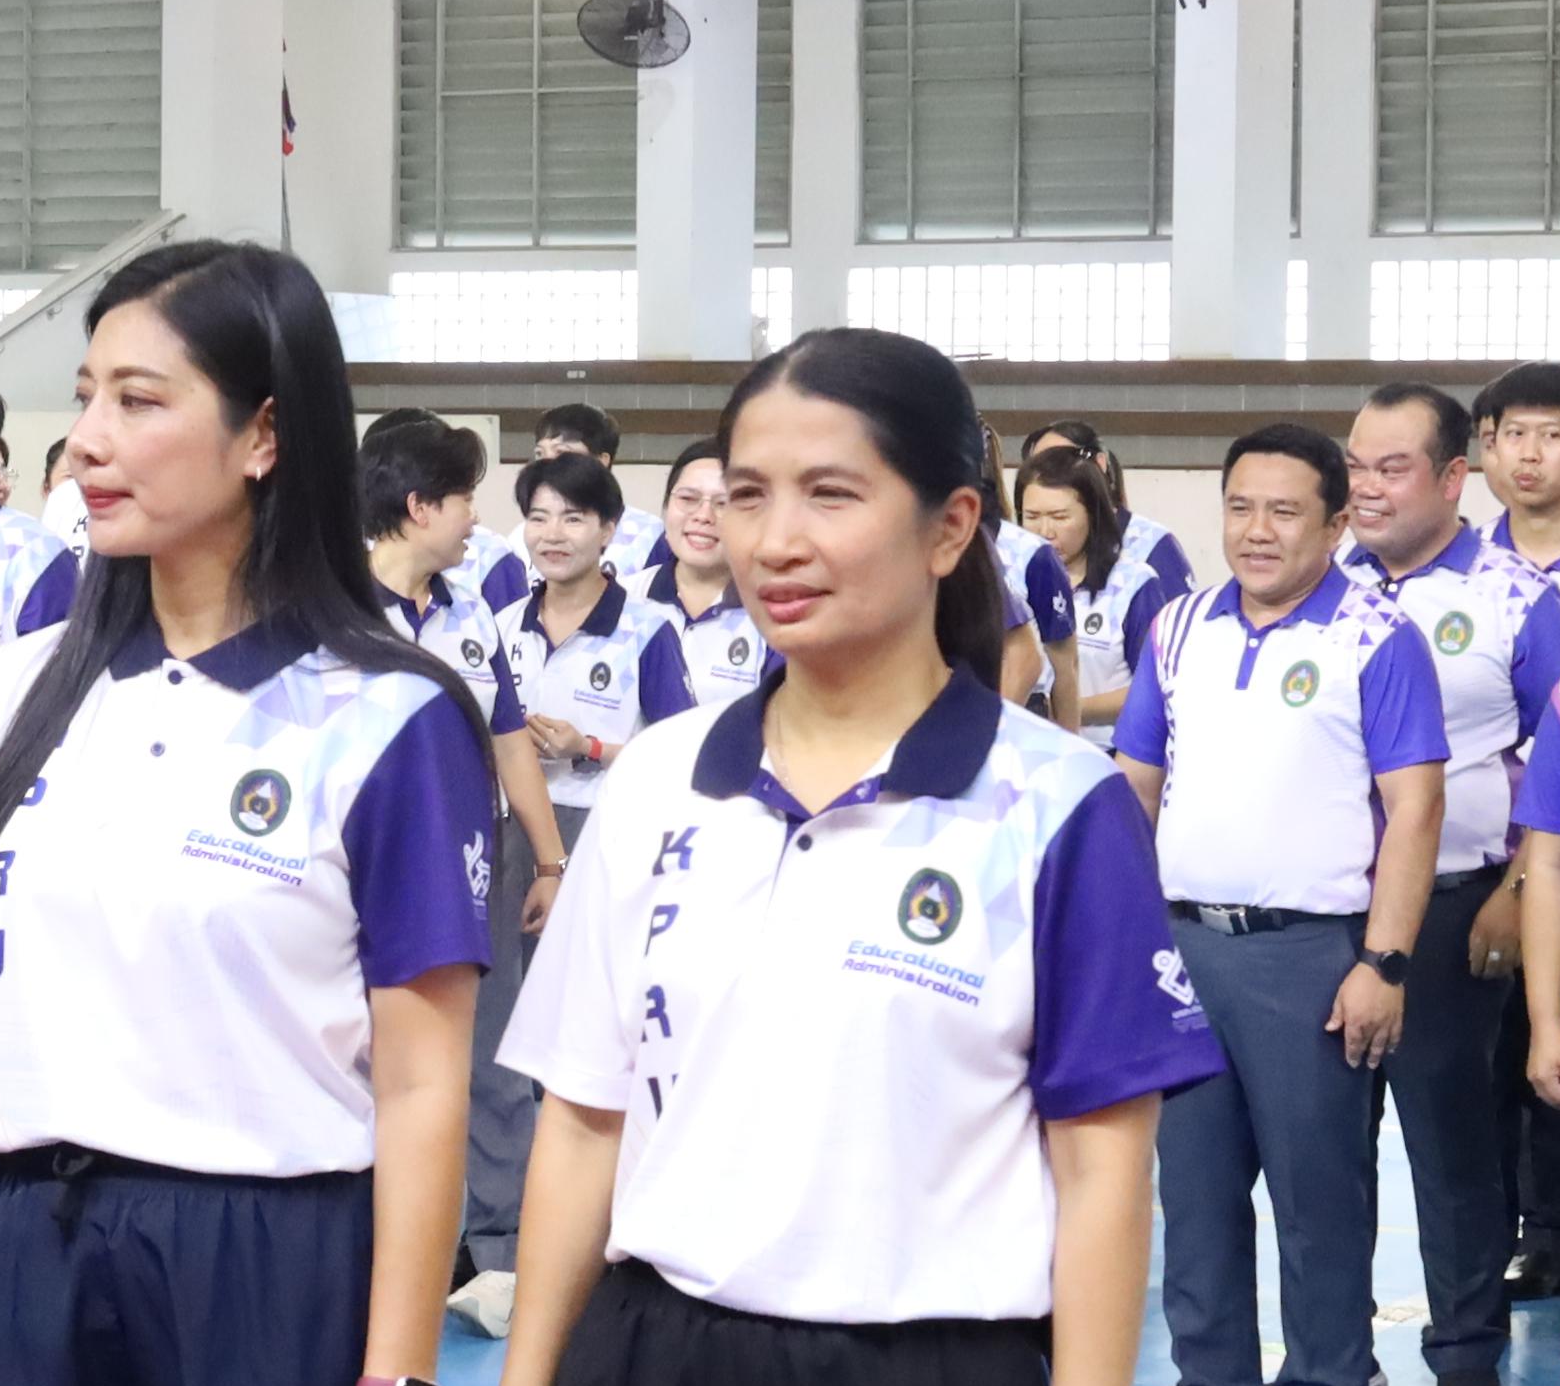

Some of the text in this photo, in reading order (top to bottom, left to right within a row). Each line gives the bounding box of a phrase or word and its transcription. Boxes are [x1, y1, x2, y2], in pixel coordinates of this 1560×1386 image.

[180, 844, 303, 887] Administration
[185, 829, 308, 871] Educational
[841, 958, 980, 1008] Administration
[846, 939, 987, 990] Educational
